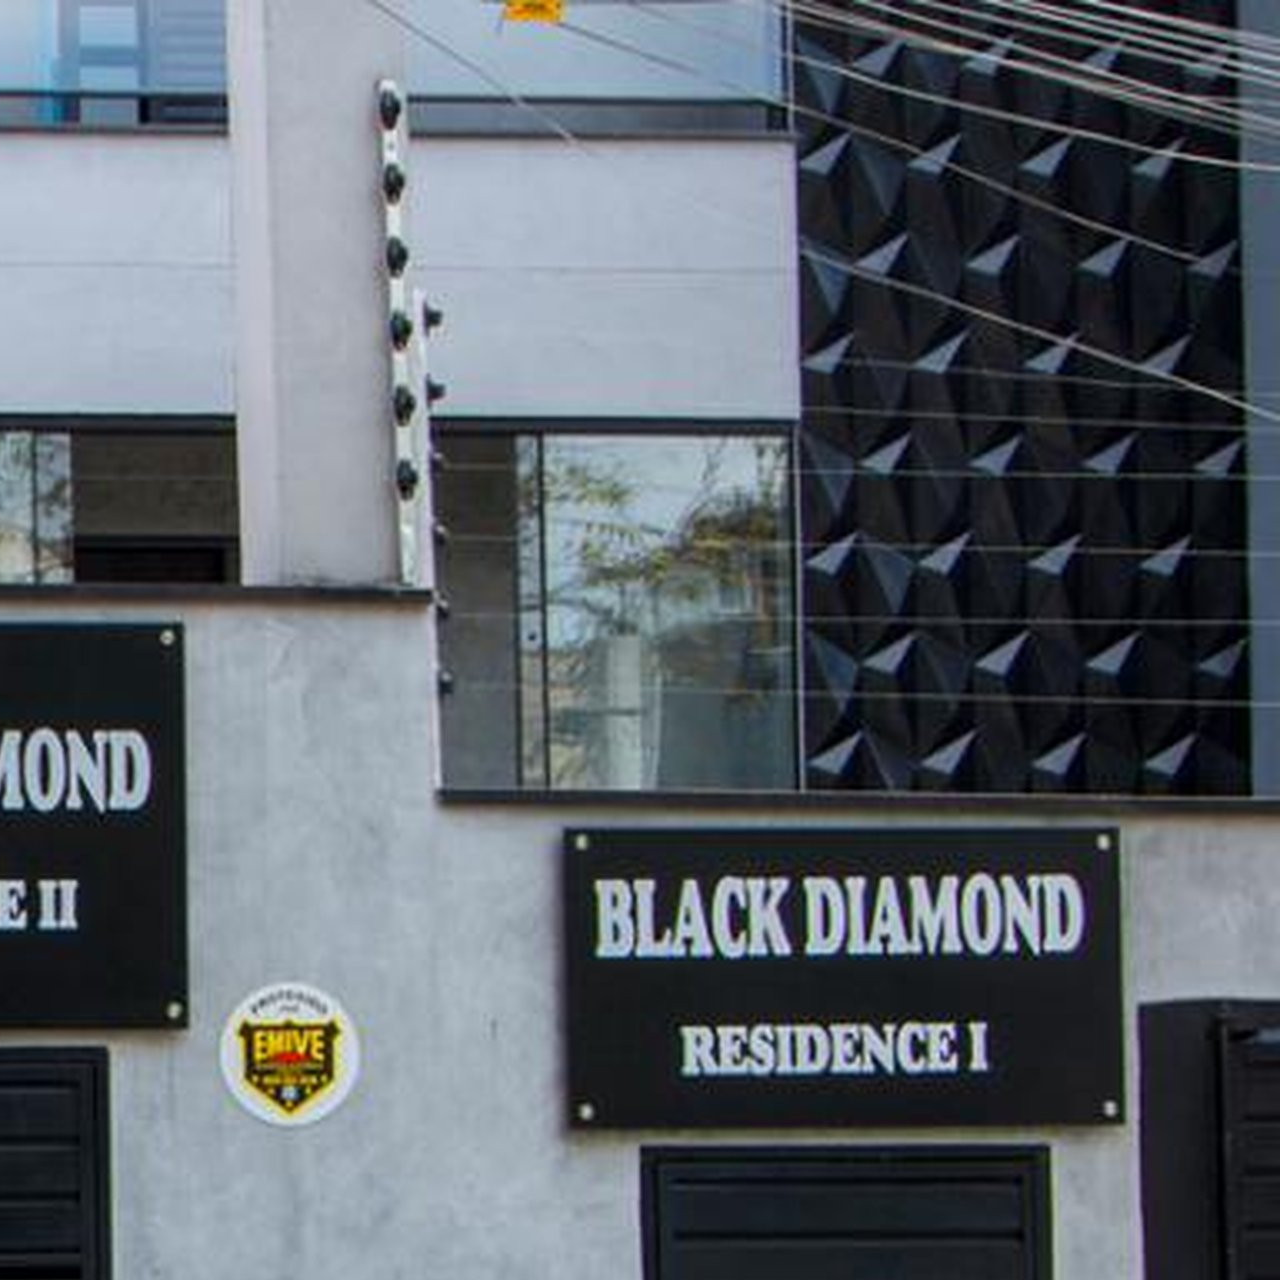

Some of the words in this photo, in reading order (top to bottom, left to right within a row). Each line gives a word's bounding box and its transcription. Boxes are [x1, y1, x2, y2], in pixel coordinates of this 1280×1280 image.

[38, 880, 78, 930] II
[594, 876, 791, 959] BLACK
[803, 872, 1086, 956] DIAMOND
[680, 1022, 960, 1076] RESIDENCE
[969, 1022, 989, 1072] I
